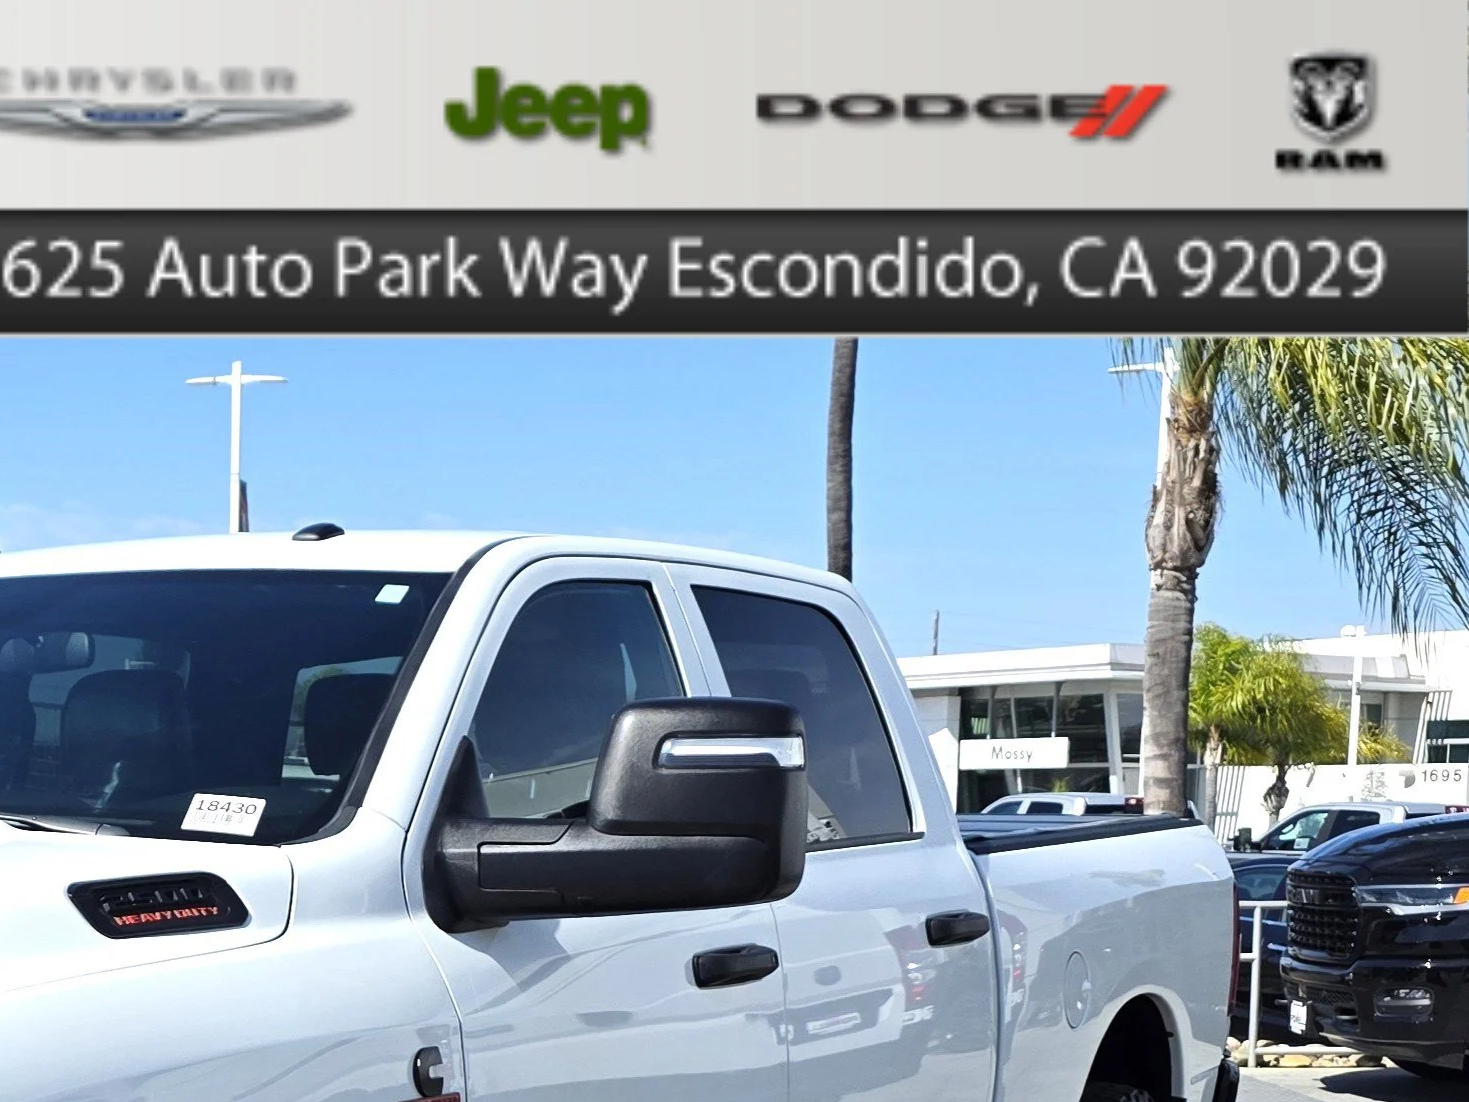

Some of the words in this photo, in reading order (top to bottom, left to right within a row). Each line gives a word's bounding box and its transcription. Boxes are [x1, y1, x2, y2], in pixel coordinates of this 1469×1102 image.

[991, 746, 1033, 762] Mossy
[1421, 769, 1462, 782] 1695
[195, 799, 257, 815] 18430
[113, 910, 173, 926] HEAVY
[173, 906, 219, 920] DUTY
